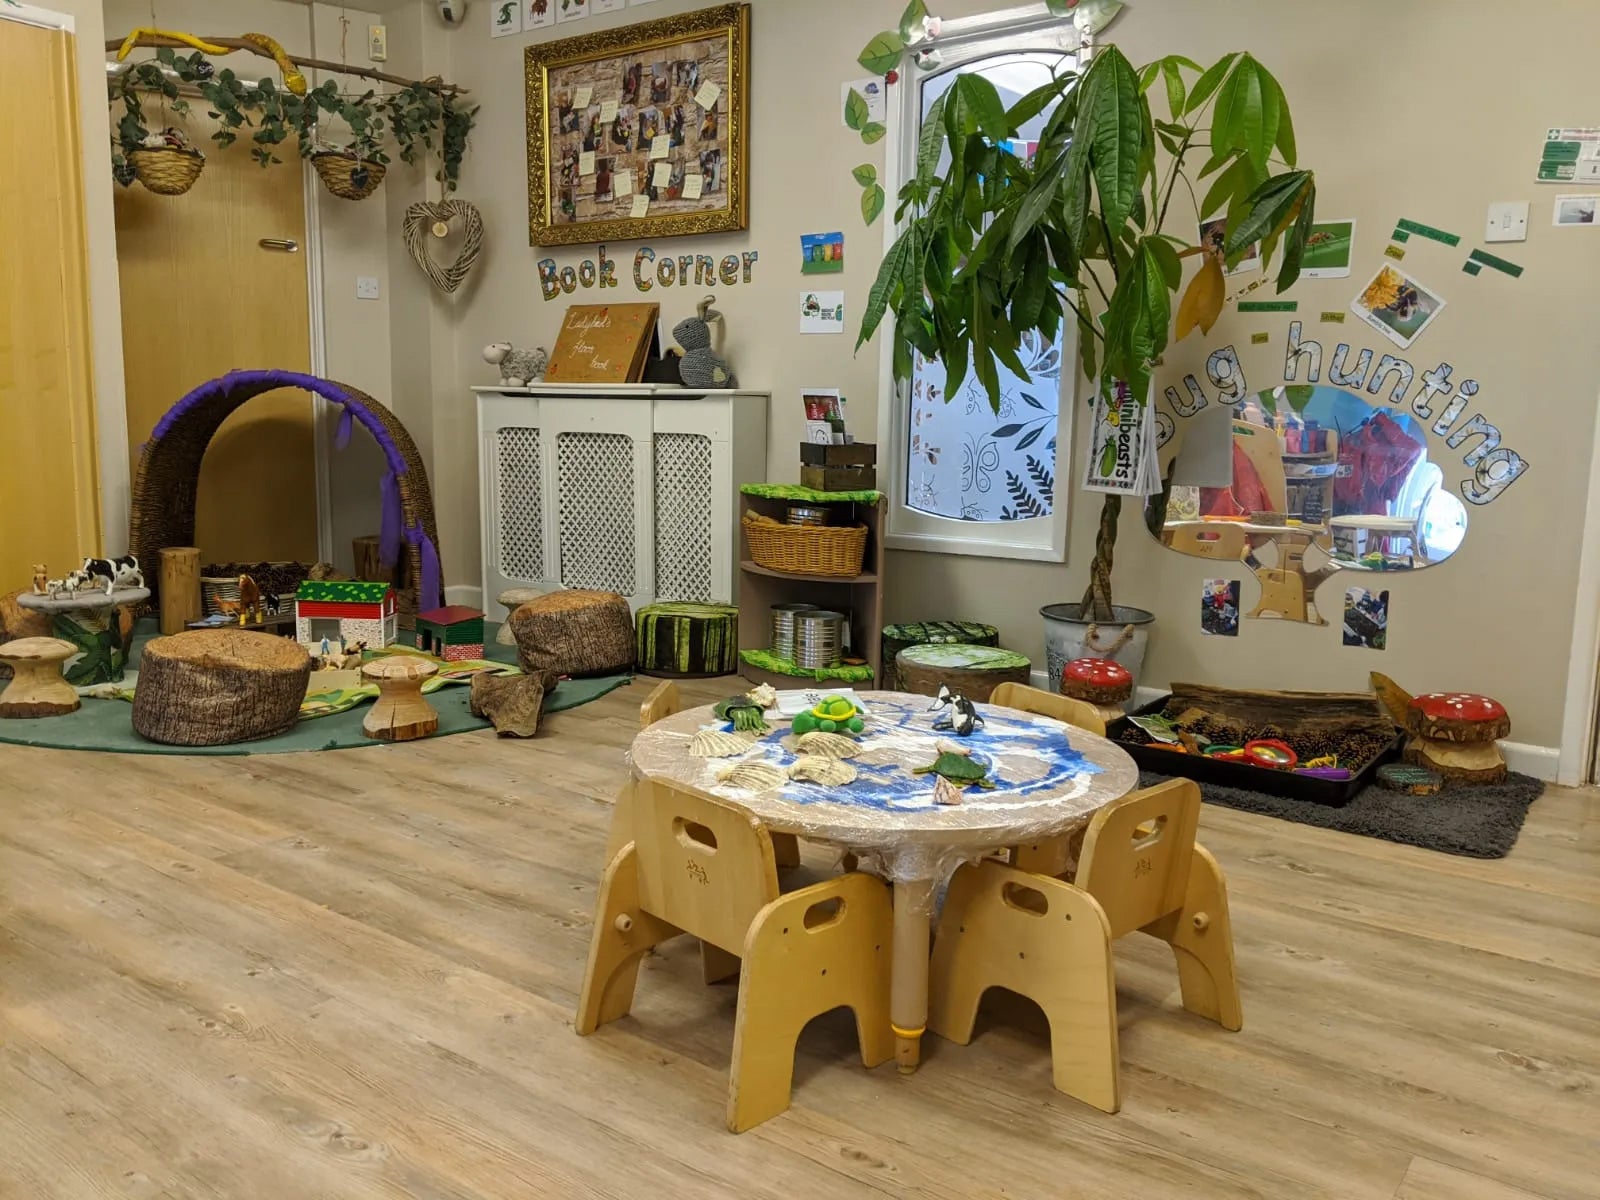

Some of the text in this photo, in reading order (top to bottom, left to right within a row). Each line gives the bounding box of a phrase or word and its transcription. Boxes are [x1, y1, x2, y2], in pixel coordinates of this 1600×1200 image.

[537, 246, 759, 301] Book Corner
[1283, 322, 1530, 505] hunting
